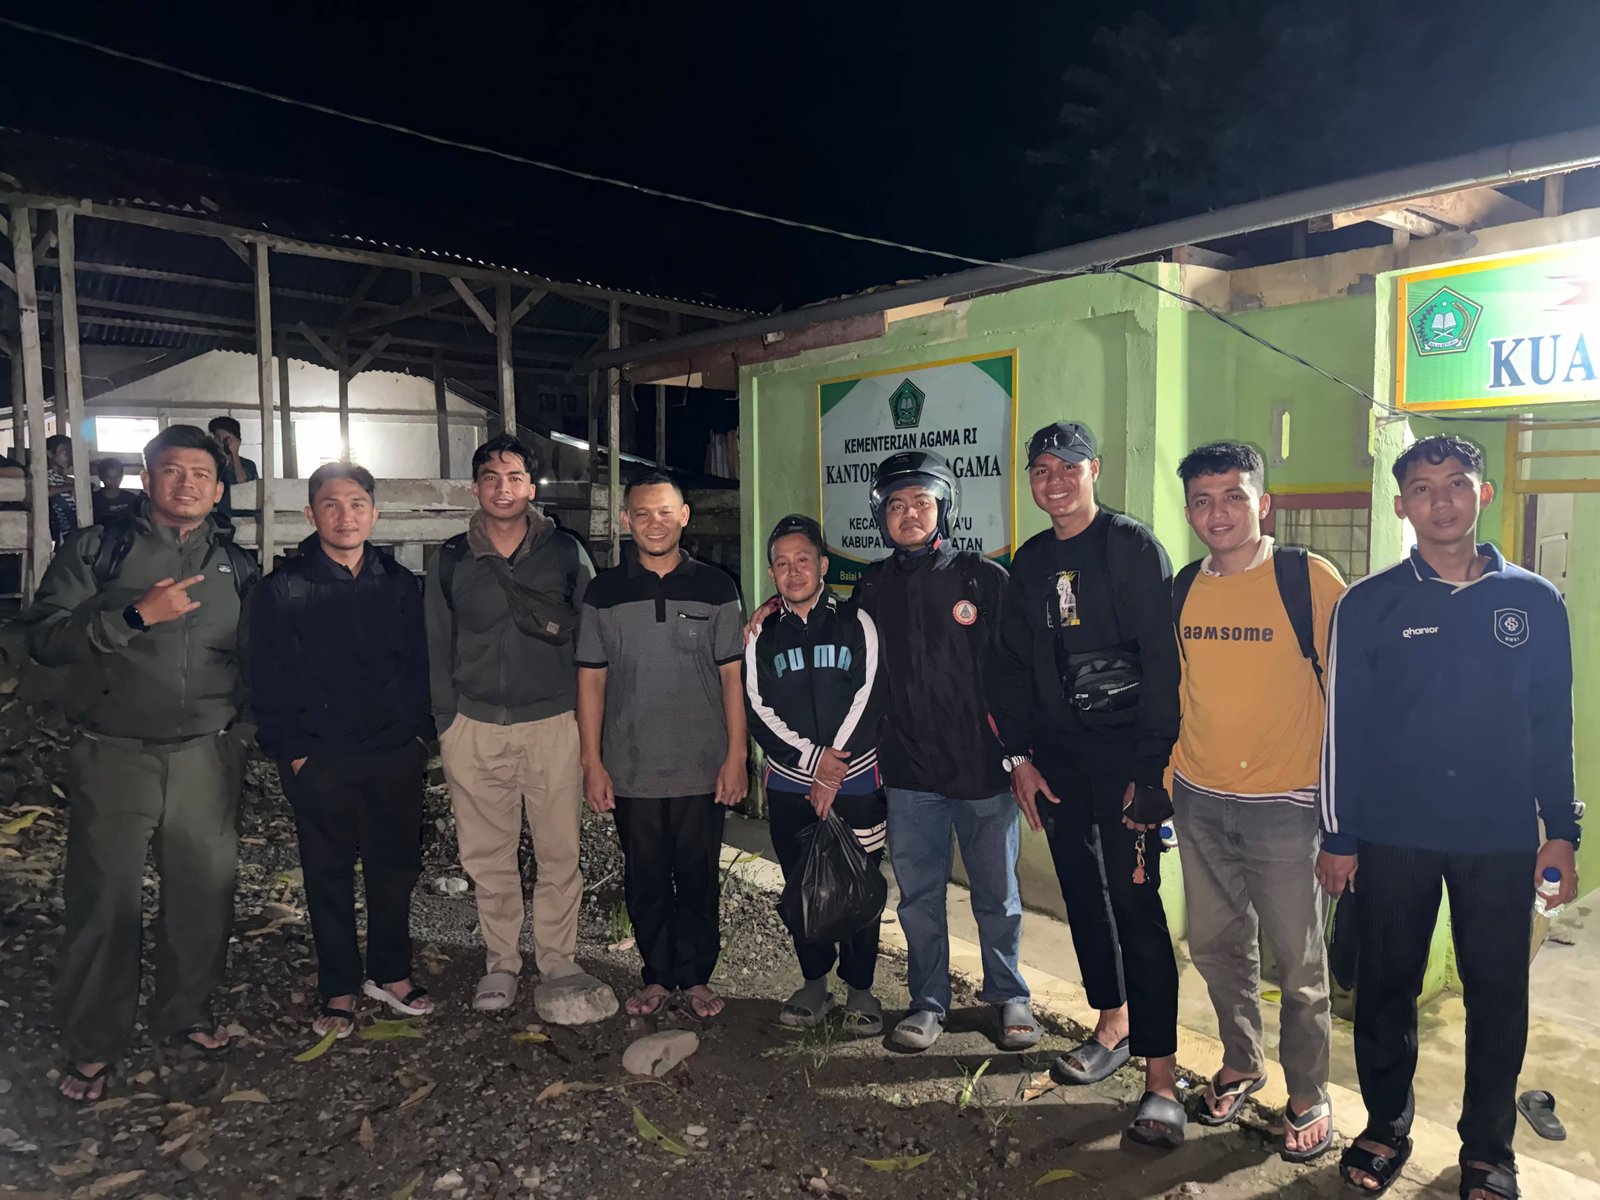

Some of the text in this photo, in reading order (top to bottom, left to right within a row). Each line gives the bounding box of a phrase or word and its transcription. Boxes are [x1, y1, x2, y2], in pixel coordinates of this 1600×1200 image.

[1489, 333, 1598, 388] KUA
[844, 427, 977, 454] KEMENTERIAN AGAMA RI
[841, 535, 983, 551] KABUPA ATAN
[773, 644, 852, 678] PUMA
